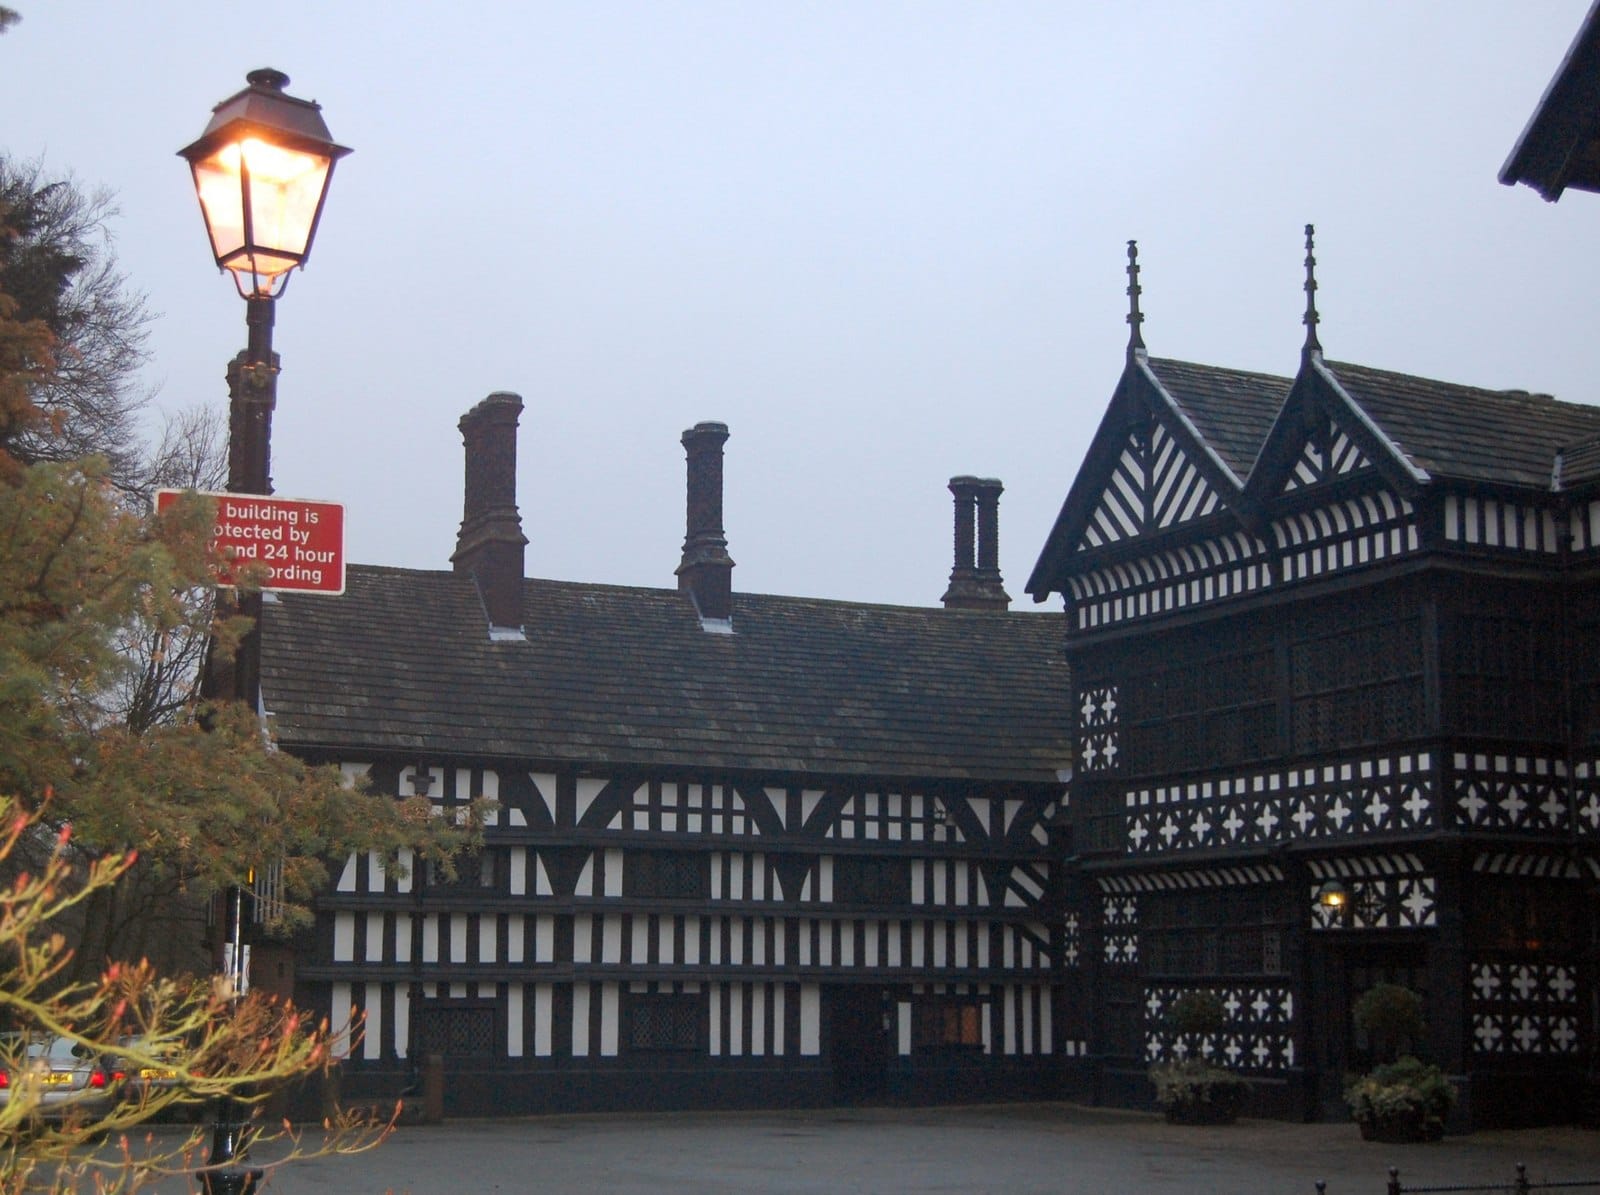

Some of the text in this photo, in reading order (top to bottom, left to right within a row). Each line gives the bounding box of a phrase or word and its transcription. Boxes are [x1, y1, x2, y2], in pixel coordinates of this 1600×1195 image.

[226, 502, 299, 524] building
[304, 508, 319, 524] is
[213, 523, 310, 545] otected by
[224, 542, 257, 558] nd
[263, 544, 289, 560] 24
[295, 546, 335, 563] hour
